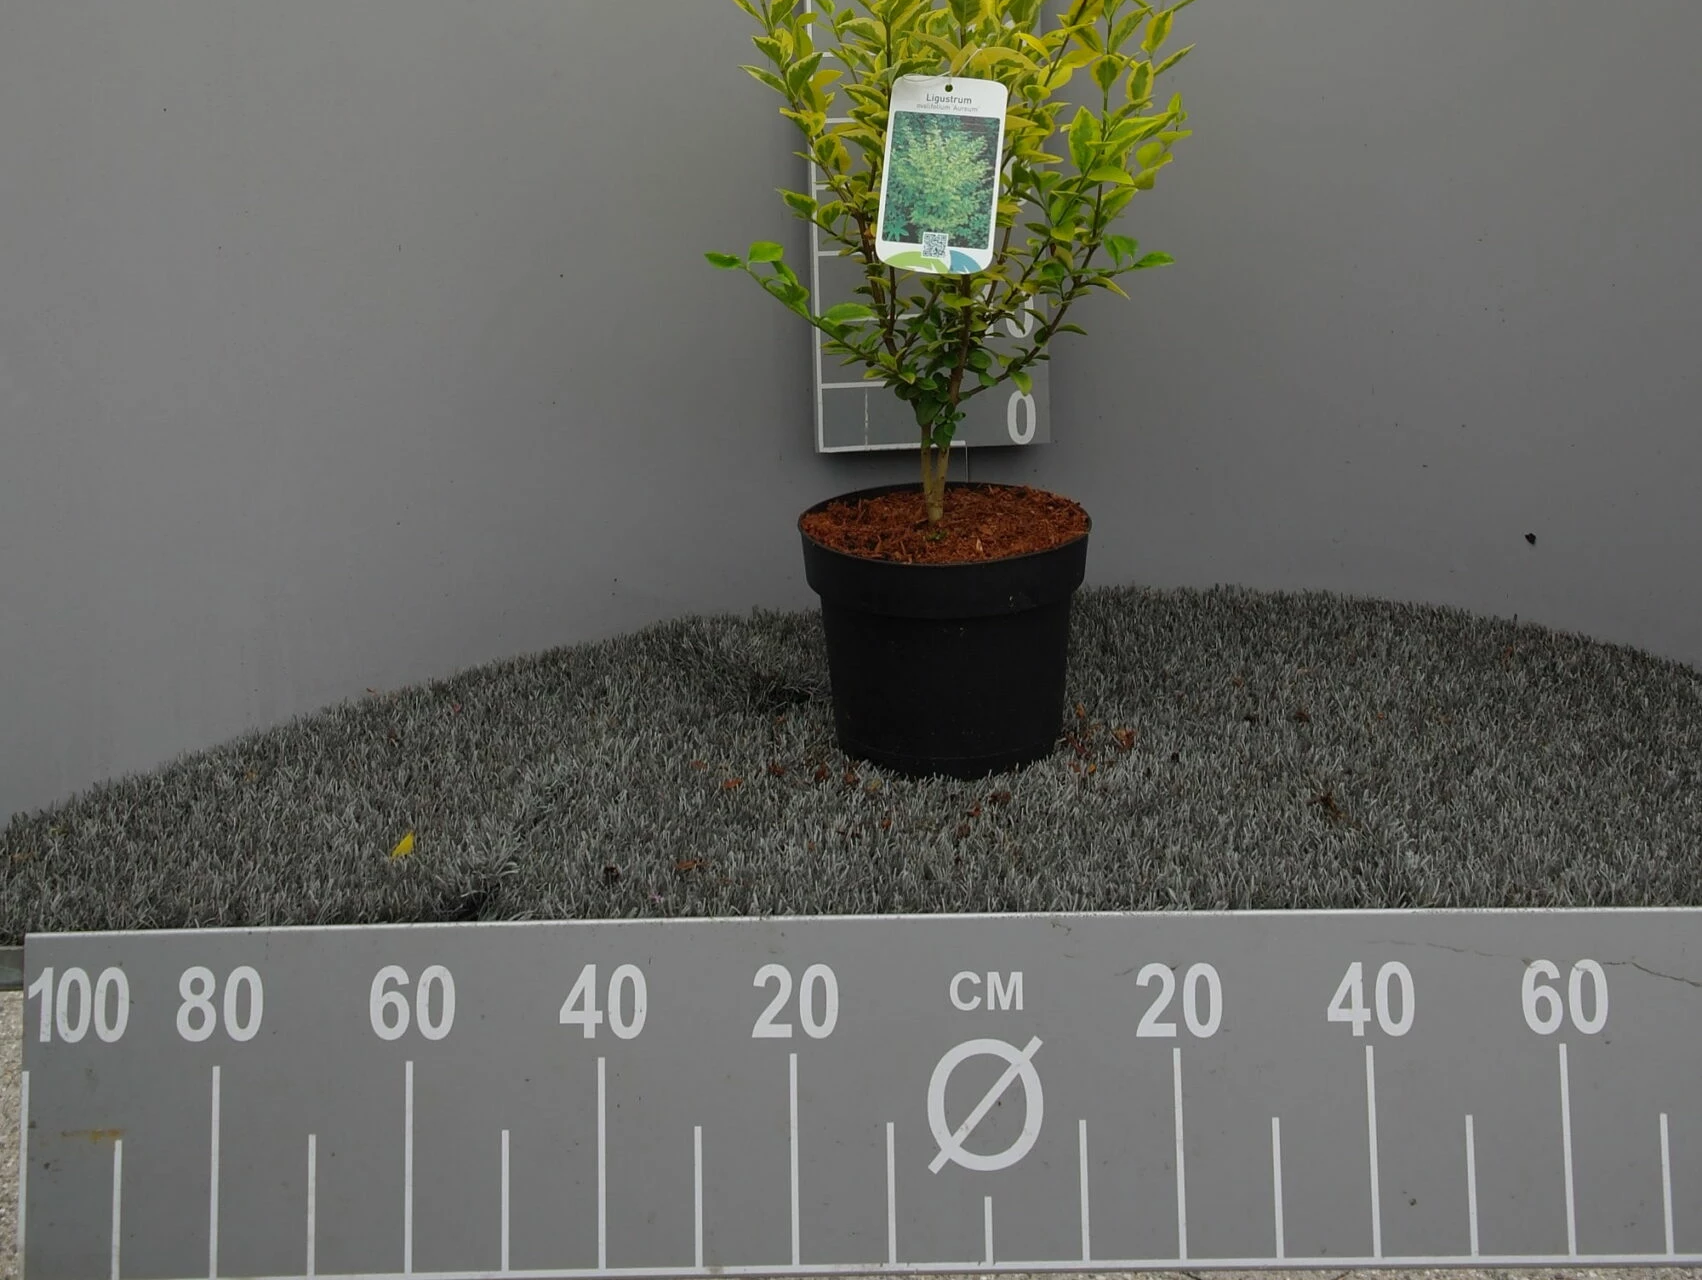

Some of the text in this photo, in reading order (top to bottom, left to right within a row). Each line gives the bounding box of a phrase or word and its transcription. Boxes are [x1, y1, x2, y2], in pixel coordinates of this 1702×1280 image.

[926, 93, 972, 104] Ligustrum
[1006, 389, 1037, 445] 0
[27, 958, 1609, 1044] 100 80 60 40 20 CM 20 40 60
